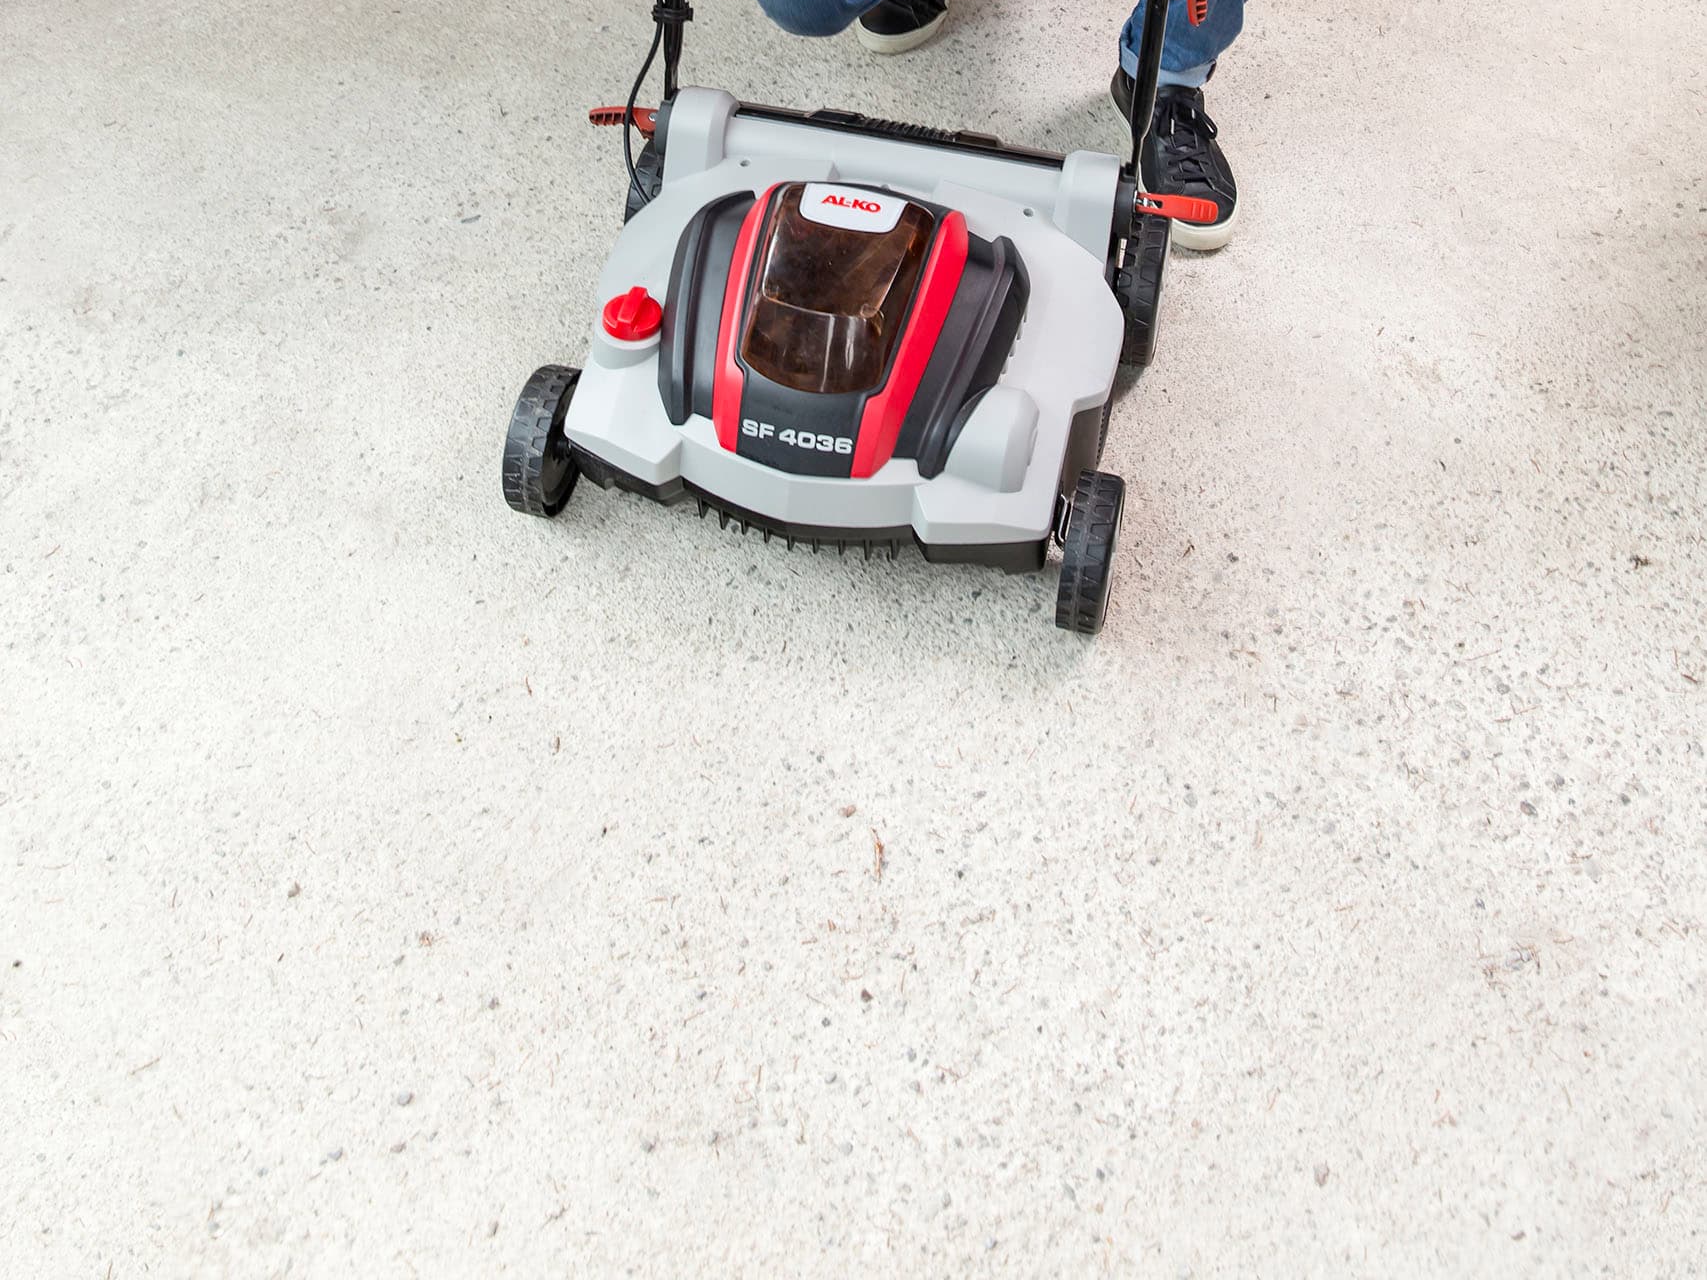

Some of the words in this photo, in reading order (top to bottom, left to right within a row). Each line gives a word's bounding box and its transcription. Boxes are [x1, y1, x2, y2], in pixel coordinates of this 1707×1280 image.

[821, 195, 881, 213] AL-KO
[742, 418, 775, 439] SF
[779, 428, 853, 454] 4036
